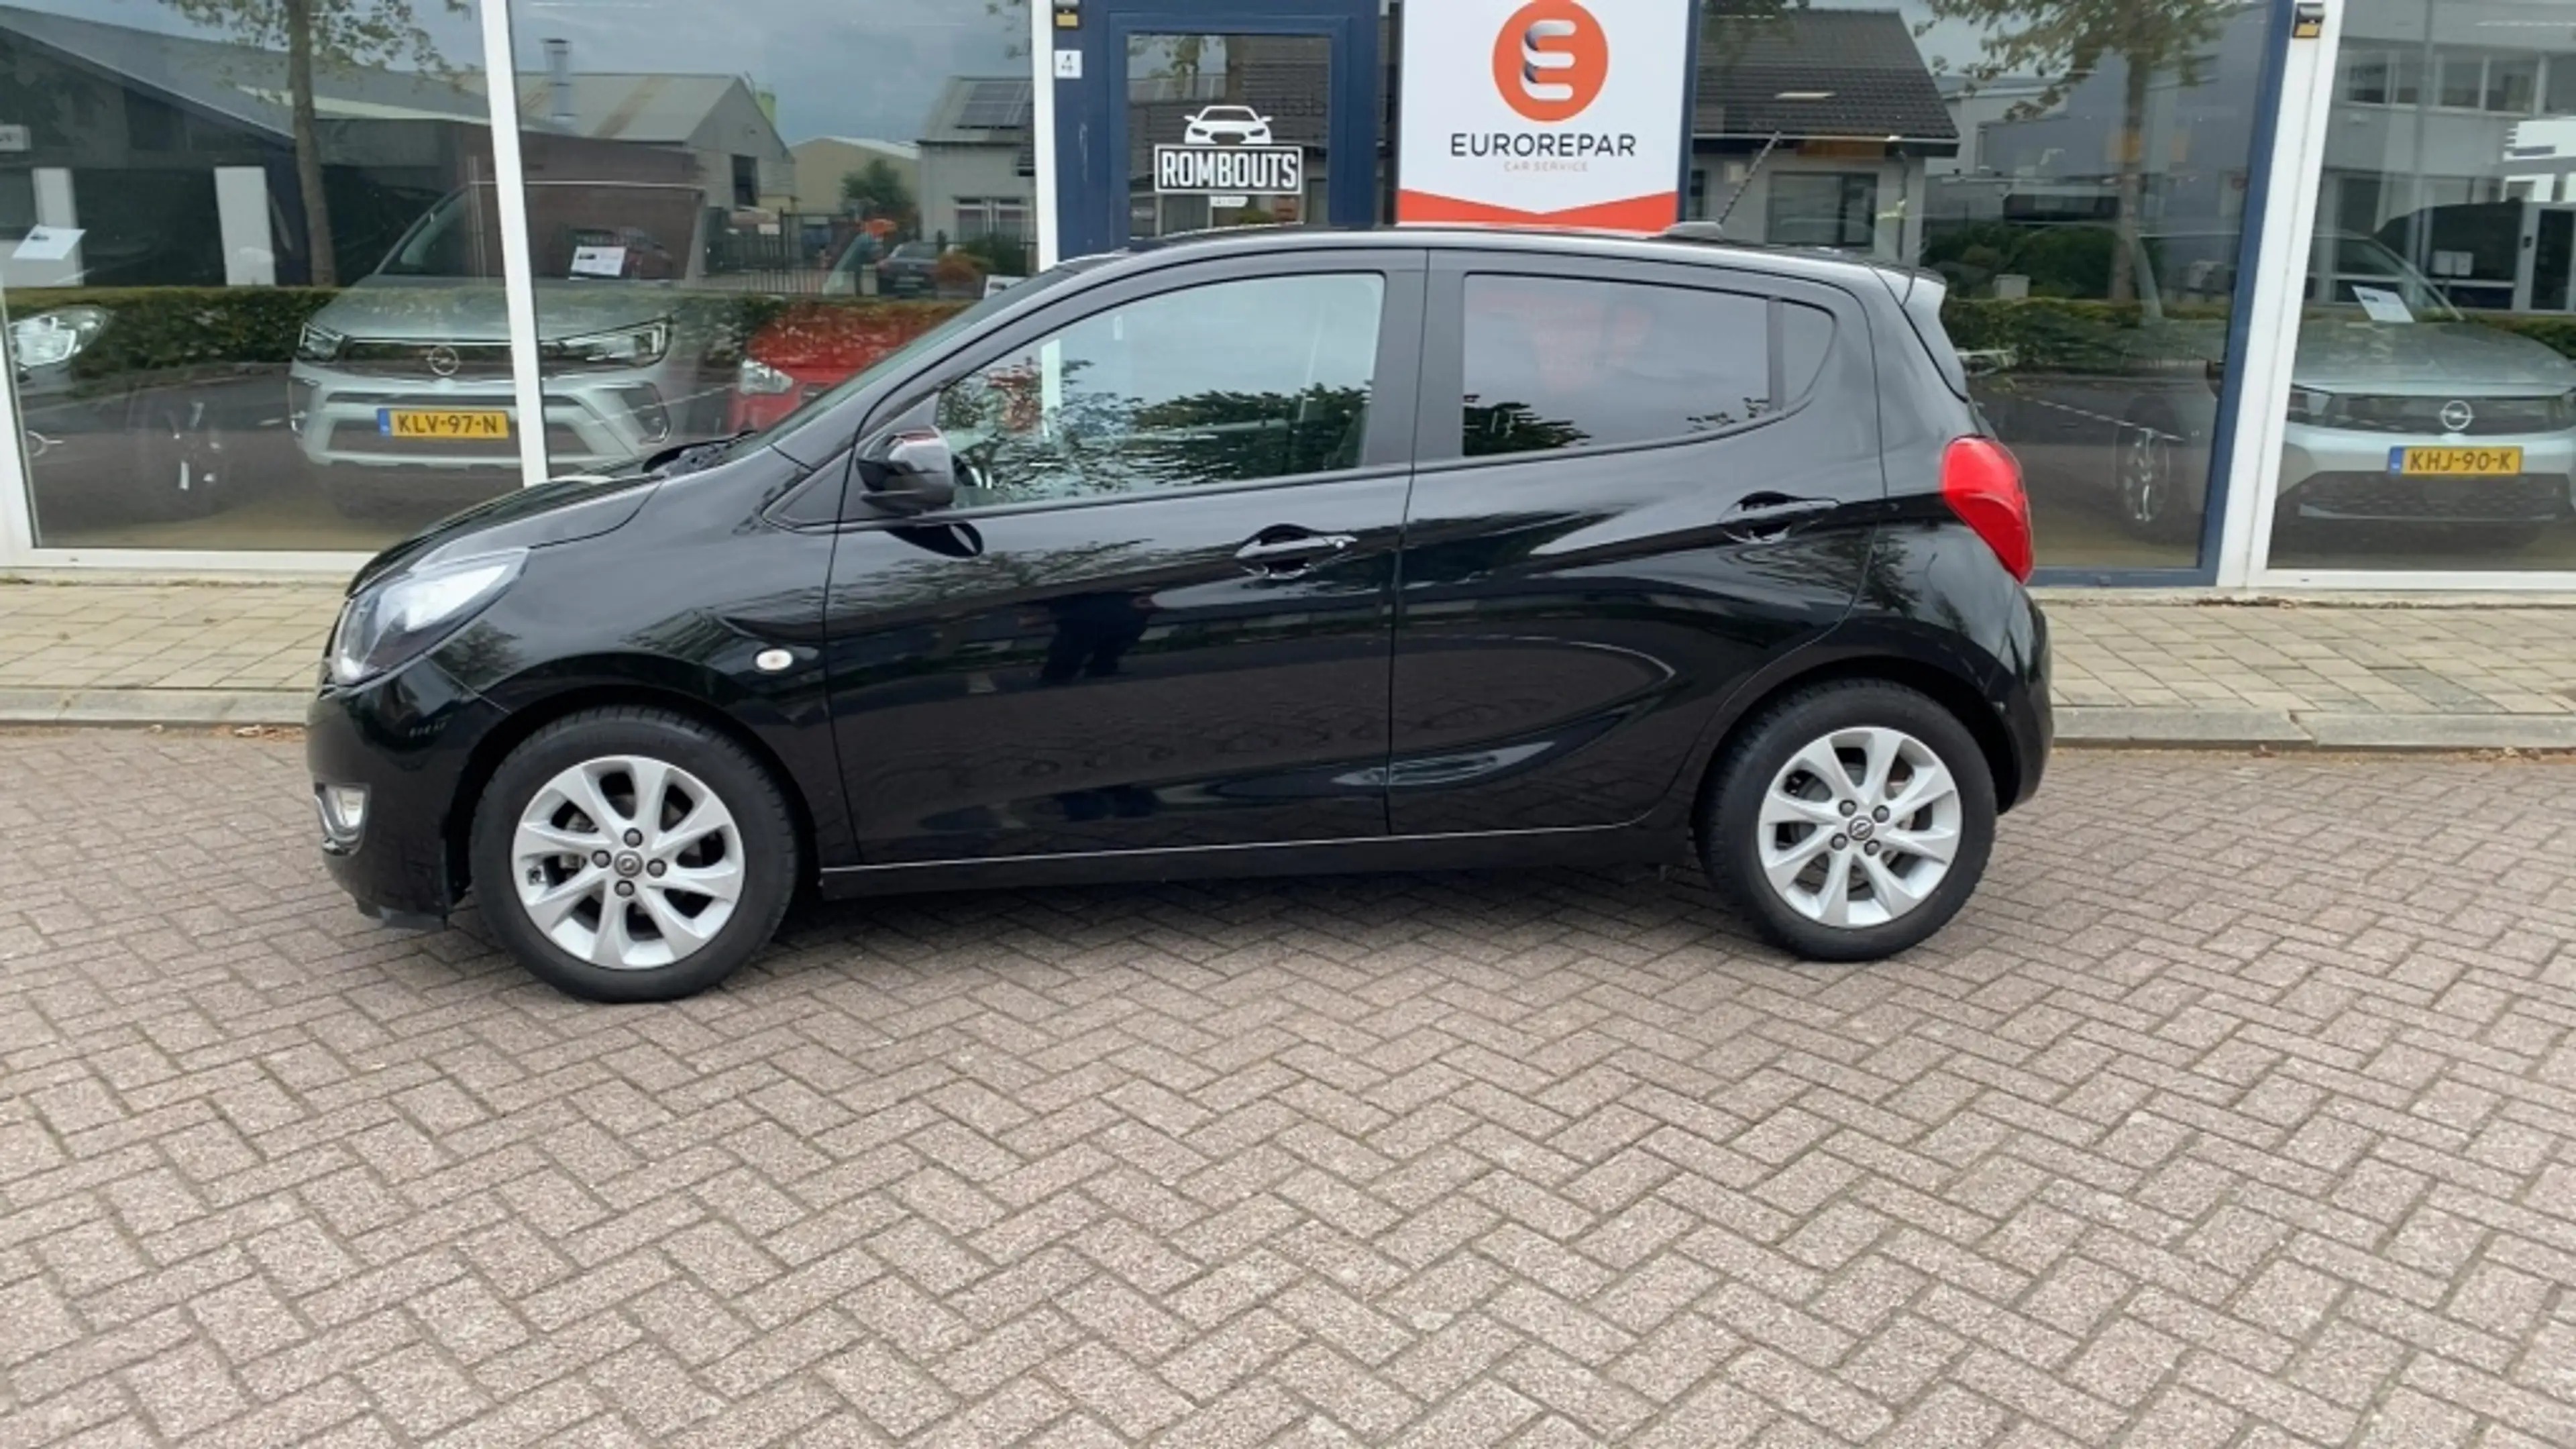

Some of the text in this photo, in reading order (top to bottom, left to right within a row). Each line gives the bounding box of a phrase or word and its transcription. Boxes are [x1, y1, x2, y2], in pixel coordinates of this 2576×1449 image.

[1450, 132, 1637, 157] EUROREPAR
[1161, 150, 1297, 189] ROMBOUTS
[1503, 160, 1589, 173] CAR SERVICE
[397, 414, 498, 434] KLV-97-N
[2410, 451, 2513, 472] KHJ-90-K
